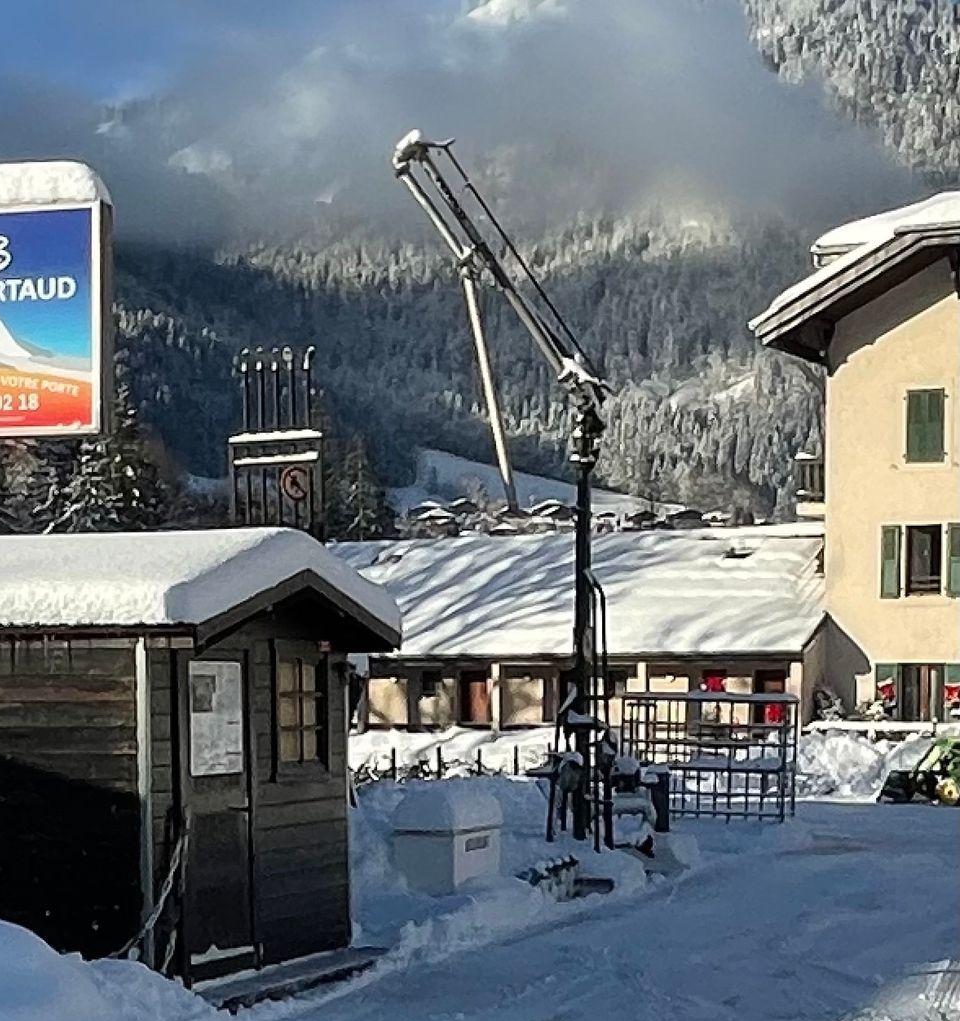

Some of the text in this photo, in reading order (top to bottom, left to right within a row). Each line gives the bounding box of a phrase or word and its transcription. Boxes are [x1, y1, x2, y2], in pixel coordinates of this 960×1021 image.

[0, 376, 40, 389] VOTRE
[41, 380, 80, 396] PORTE
[18, 393, 39, 410] 18
